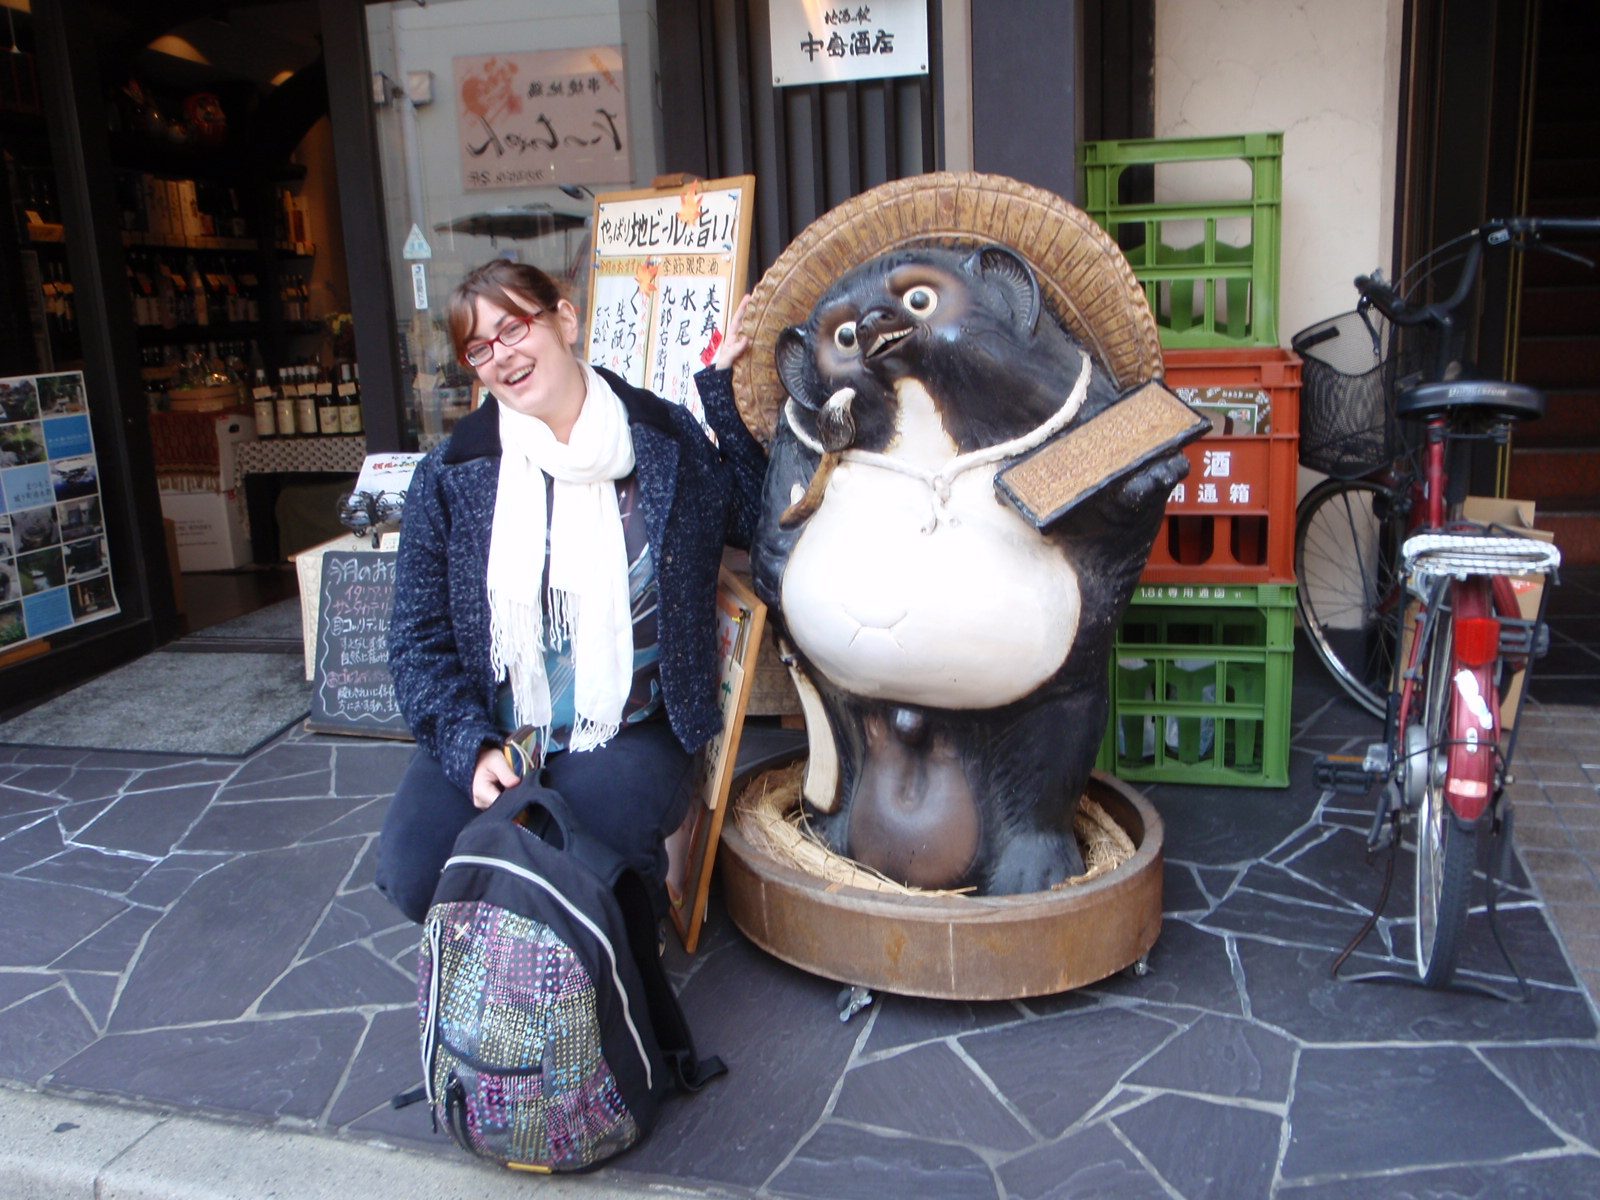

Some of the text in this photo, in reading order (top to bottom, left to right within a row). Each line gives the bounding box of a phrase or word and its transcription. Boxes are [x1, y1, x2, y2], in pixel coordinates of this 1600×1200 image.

[800, 29, 895, 62] 中島酒店
[1203, 450, 1231, 478] 酒
